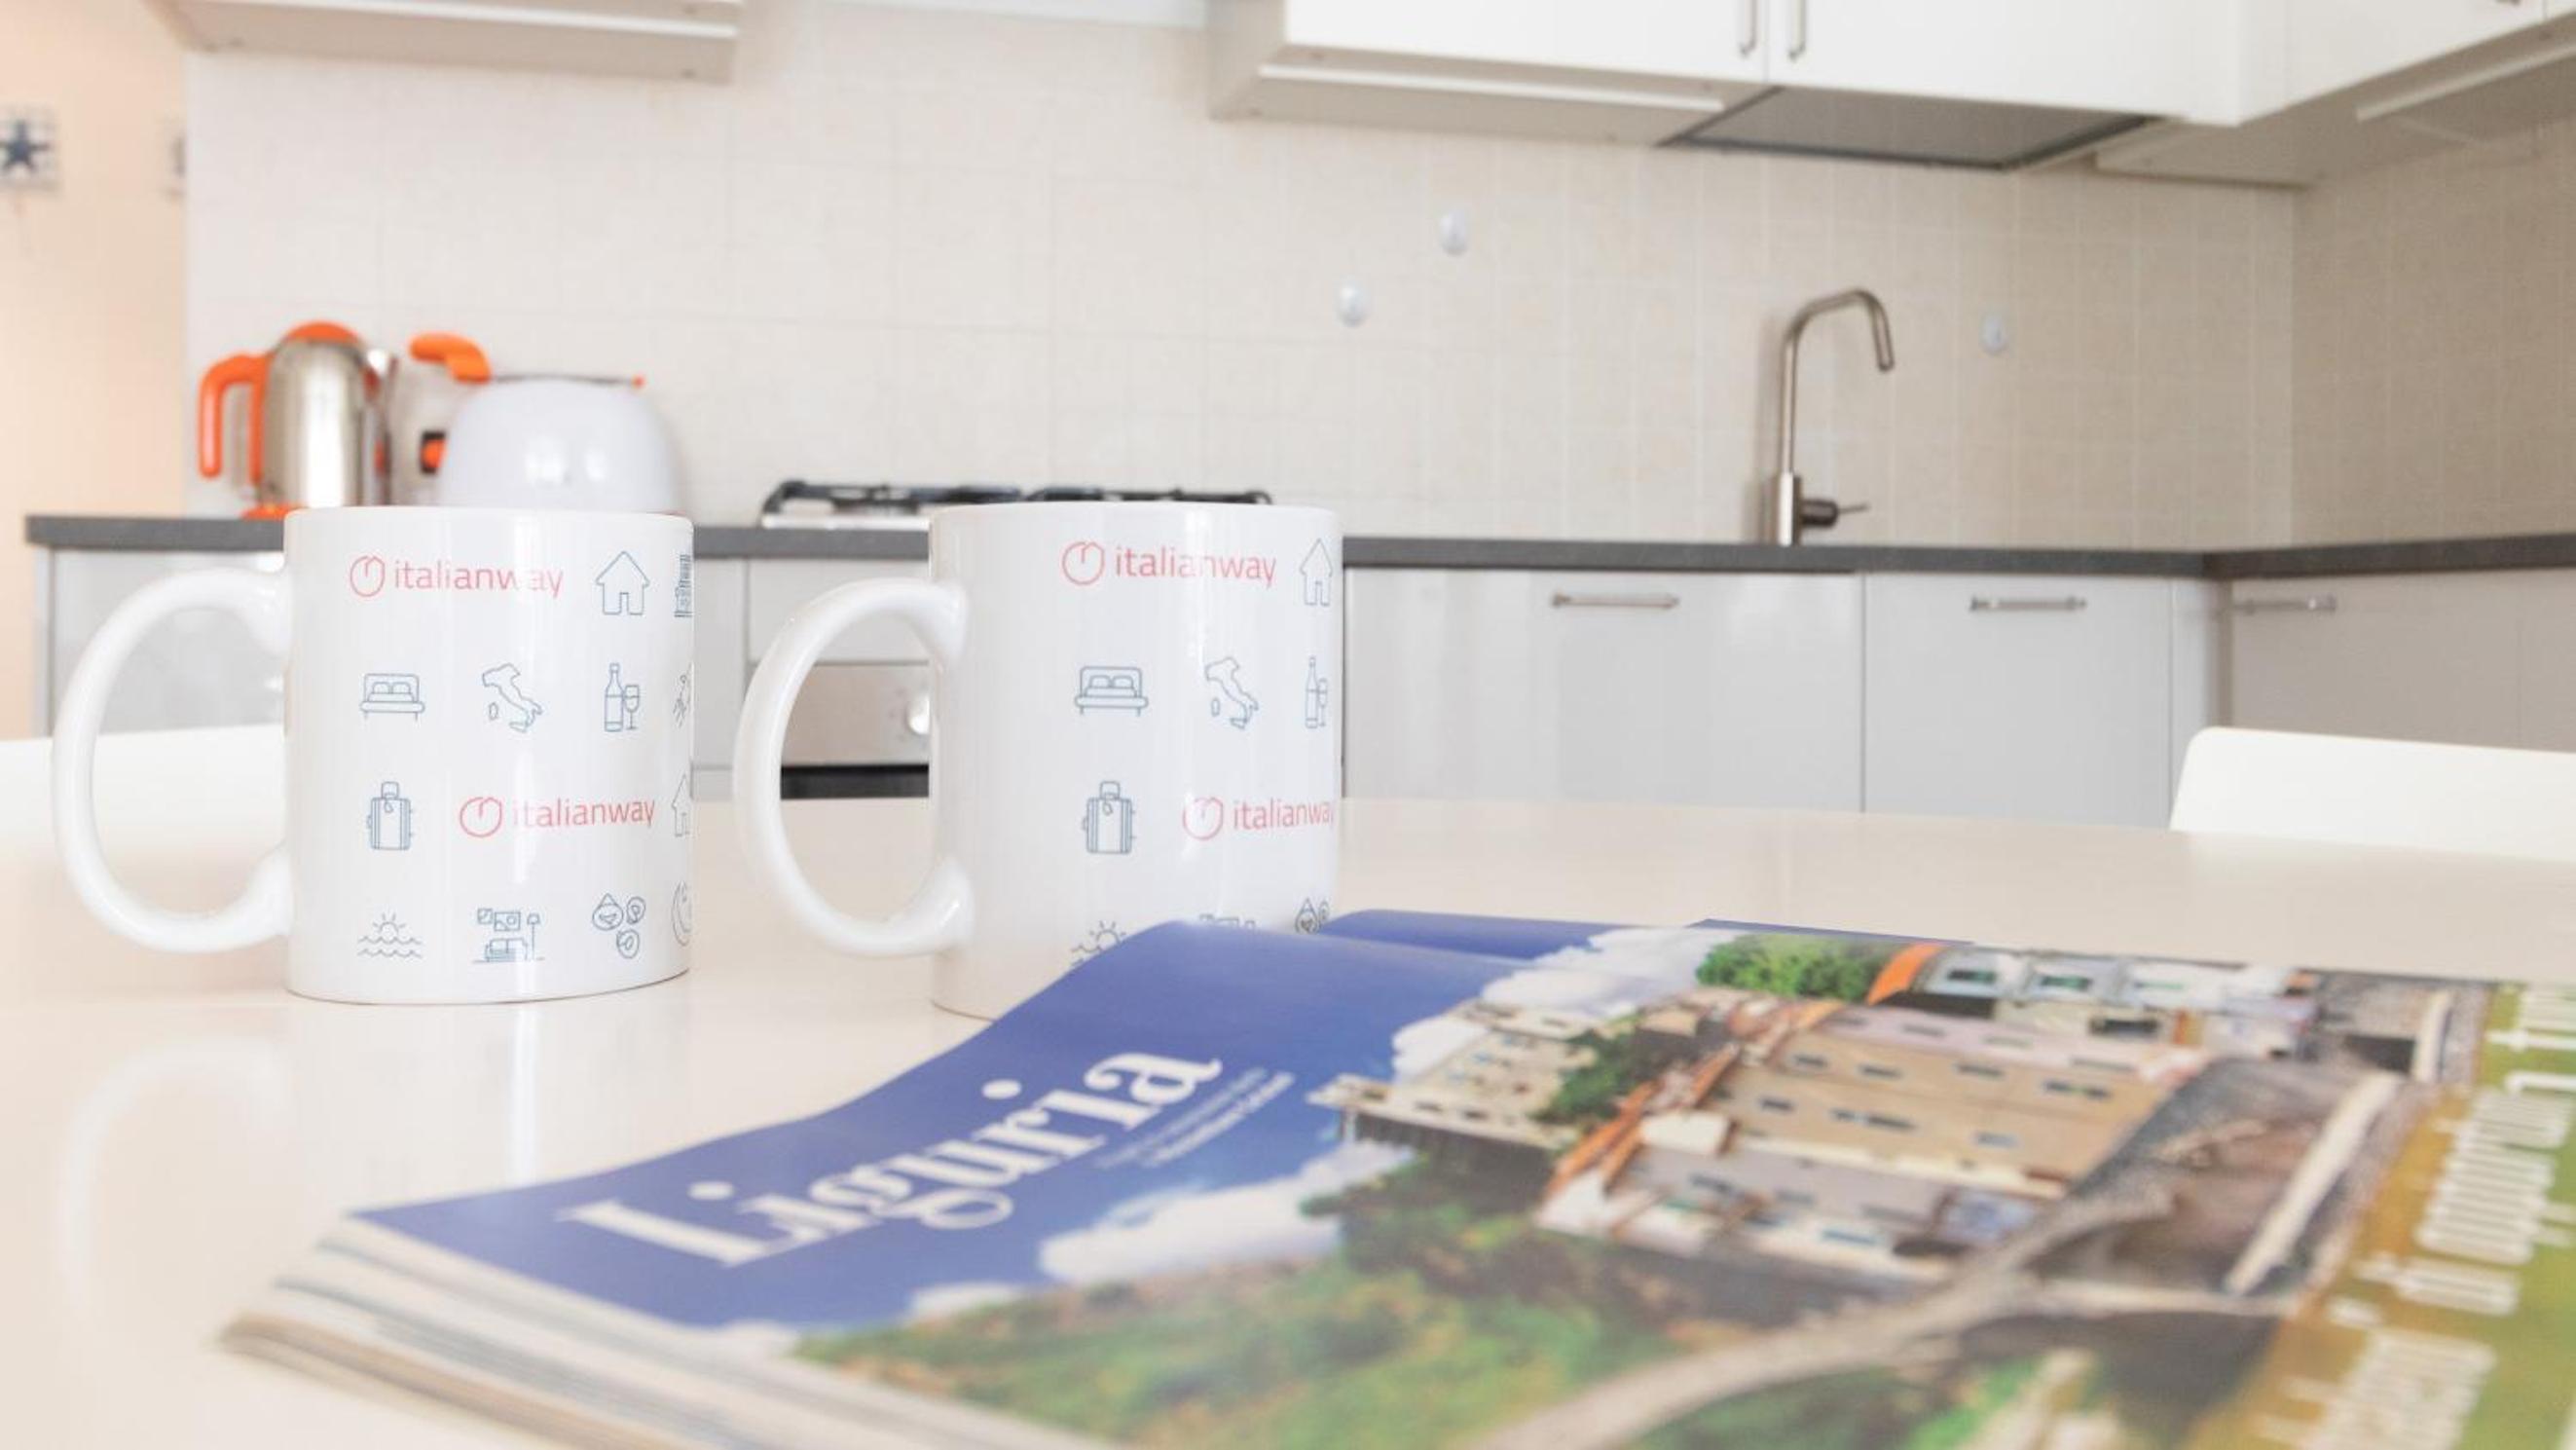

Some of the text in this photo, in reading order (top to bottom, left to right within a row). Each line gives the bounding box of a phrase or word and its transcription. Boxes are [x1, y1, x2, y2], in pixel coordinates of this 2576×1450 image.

[393, 556, 564, 598] italianway
[1114, 545, 1277, 586] italianway
[511, 795, 657, 828] italianway
[558, 1052, 1223, 1266] Liguria
